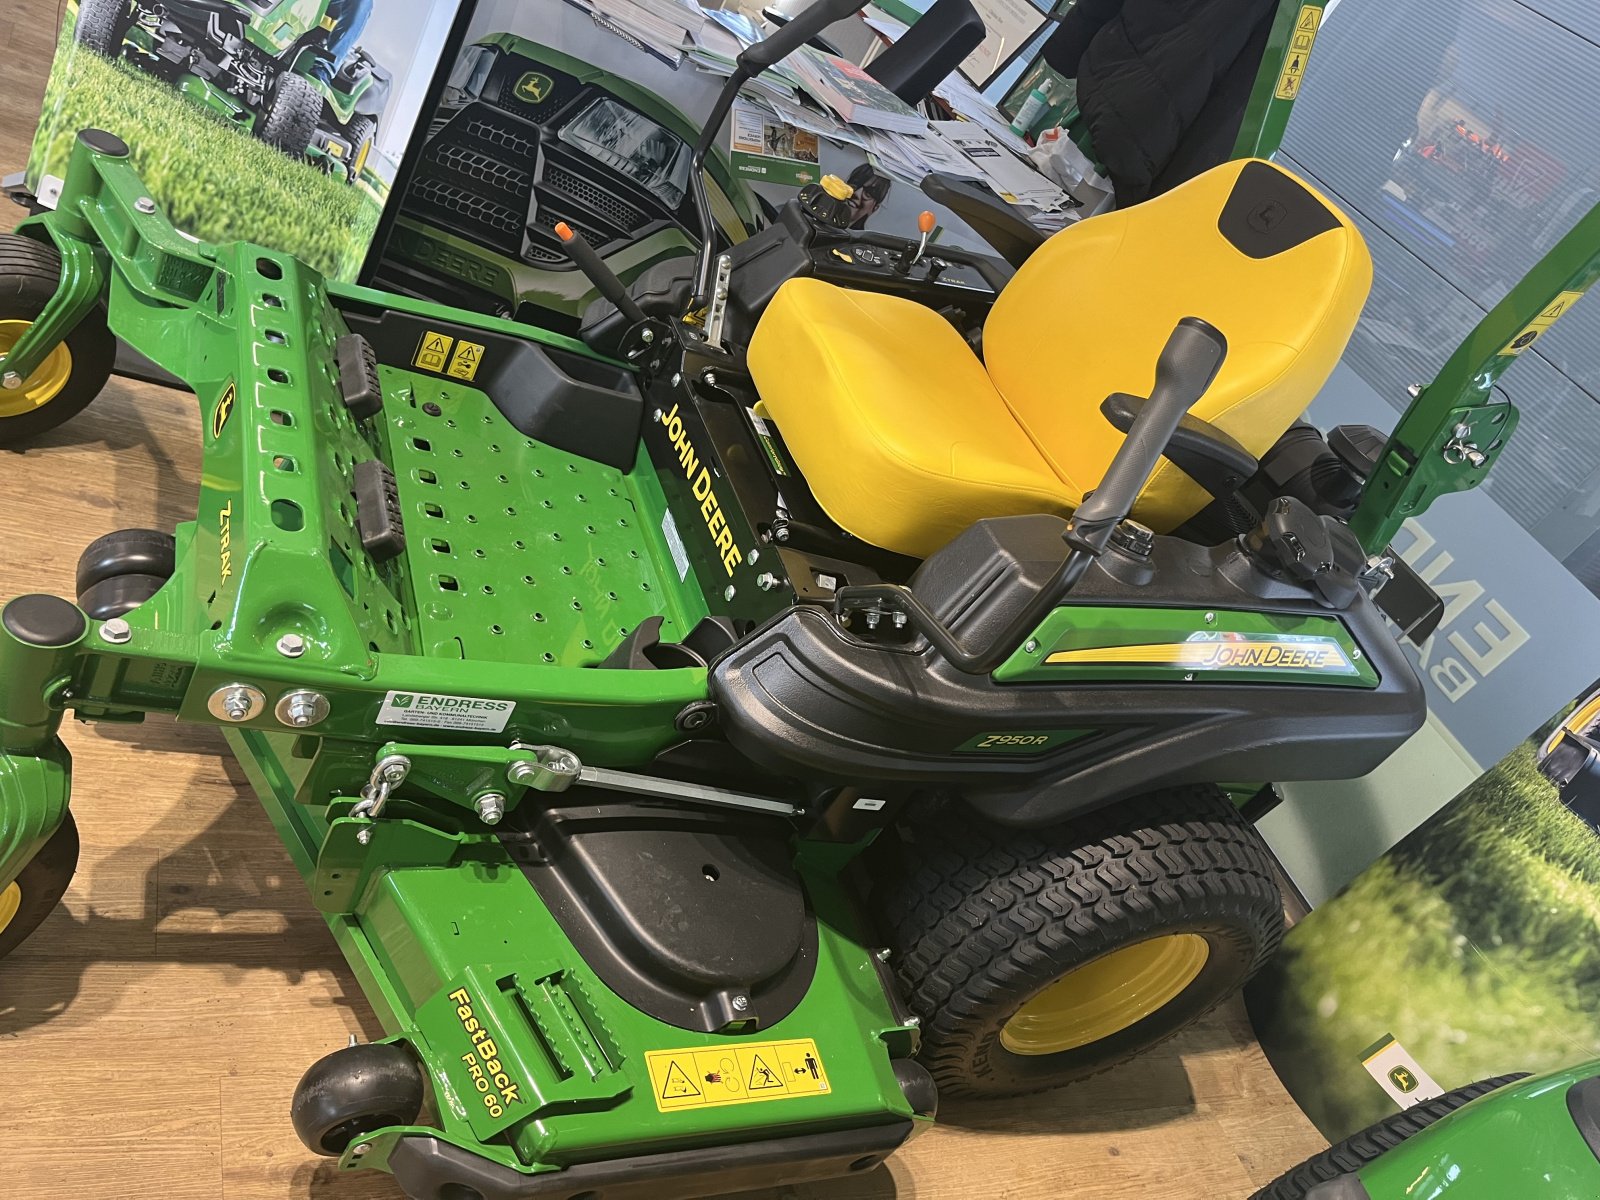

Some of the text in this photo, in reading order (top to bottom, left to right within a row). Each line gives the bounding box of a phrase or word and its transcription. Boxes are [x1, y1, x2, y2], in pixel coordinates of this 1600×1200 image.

[413, 240, 499, 287] DEERE
[661, 403, 700, 480] JOHN
[692, 466, 743, 578] DEERE
[219, 498, 232, 587] ZTRAK
[1204, 644, 1329, 668] JOHN DEERE
[415, 704, 469, 713] BAYERN
[417, 696, 508, 711] ENDRESS
[977, 734, 1050, 748] Z950R
[448, 986, 522, 1108] FastBack
[461, 1052, 503, 1119] PRO 60
